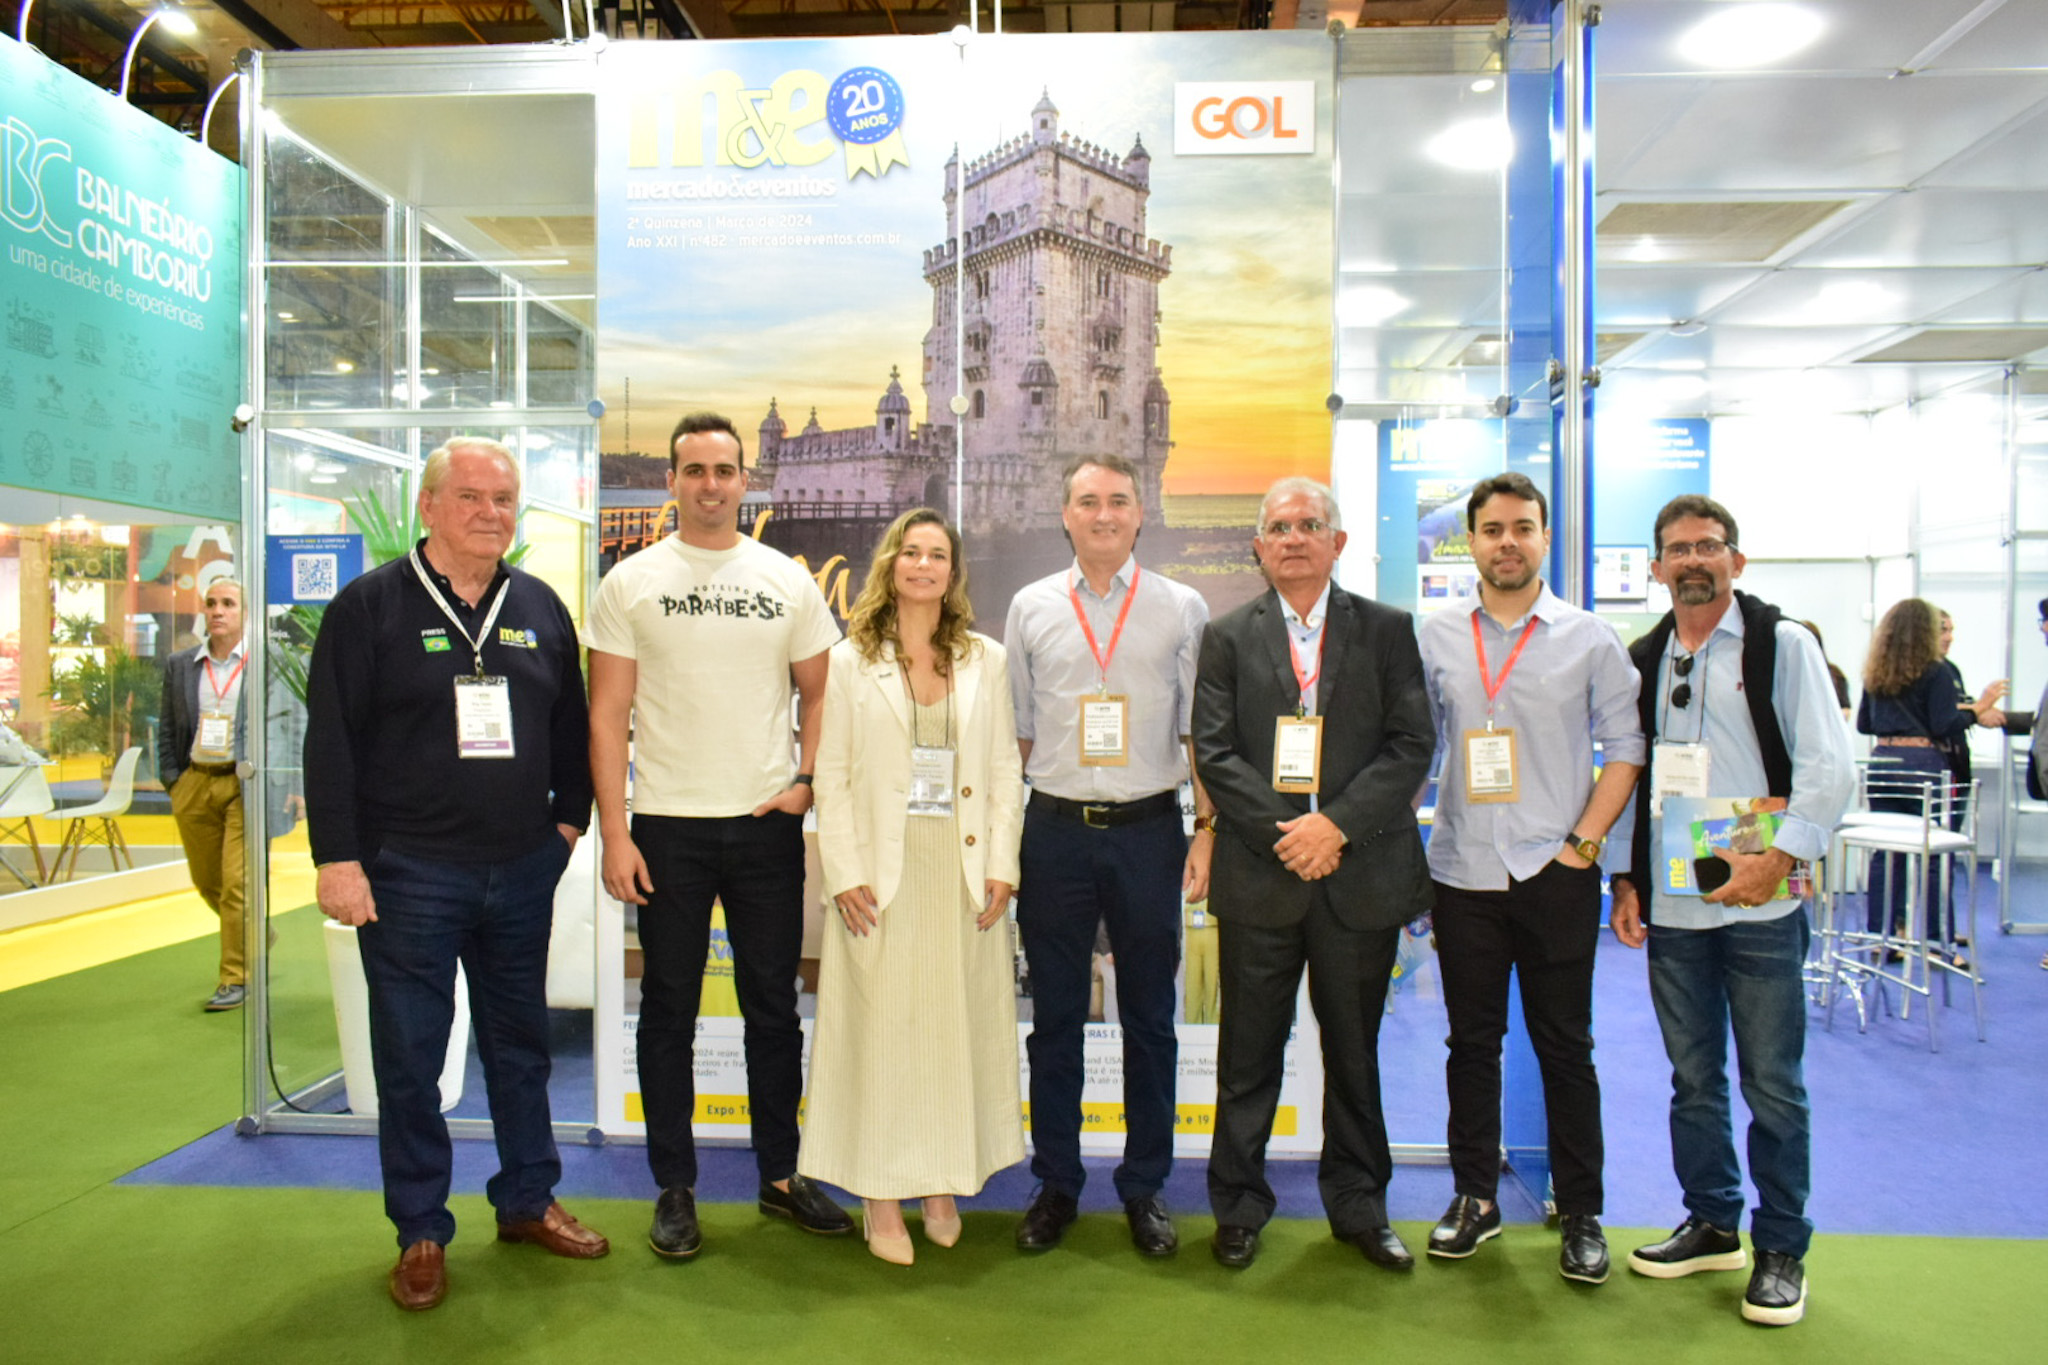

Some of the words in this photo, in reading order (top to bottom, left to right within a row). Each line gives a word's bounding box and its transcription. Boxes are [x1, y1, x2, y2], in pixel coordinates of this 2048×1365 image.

[842, 79, 885, 118] 20
[850, 112, 889, 132] ANOS
[1191, 96, 1298, 140] GOL
[627, 175, 836, 200] mercado&eventos
[77, 166, 213, 262] BALNEÁRIO
[644, 216, 702, 230] Quinzena
[715, 215, 754, 229] Março
[759, 215, 775, 228] de
[779, 214, 812, 227] 2024
[627, 236, 651, 249] Ano
[656, 235, 677, 248] XXI
[78, 218, 213, 303] CAMBORIÚ
[10, 244, 47, 273] uma
[51, 255, 101, 293] cidade
[104, 277, 122, 301] de
[126, 286, 204, 331] experiências
[694, 584, 749, 595] ROTEIRO
[421, 628, 447, 637] PRESS
[707, 1104, 734, 1117] Expo
